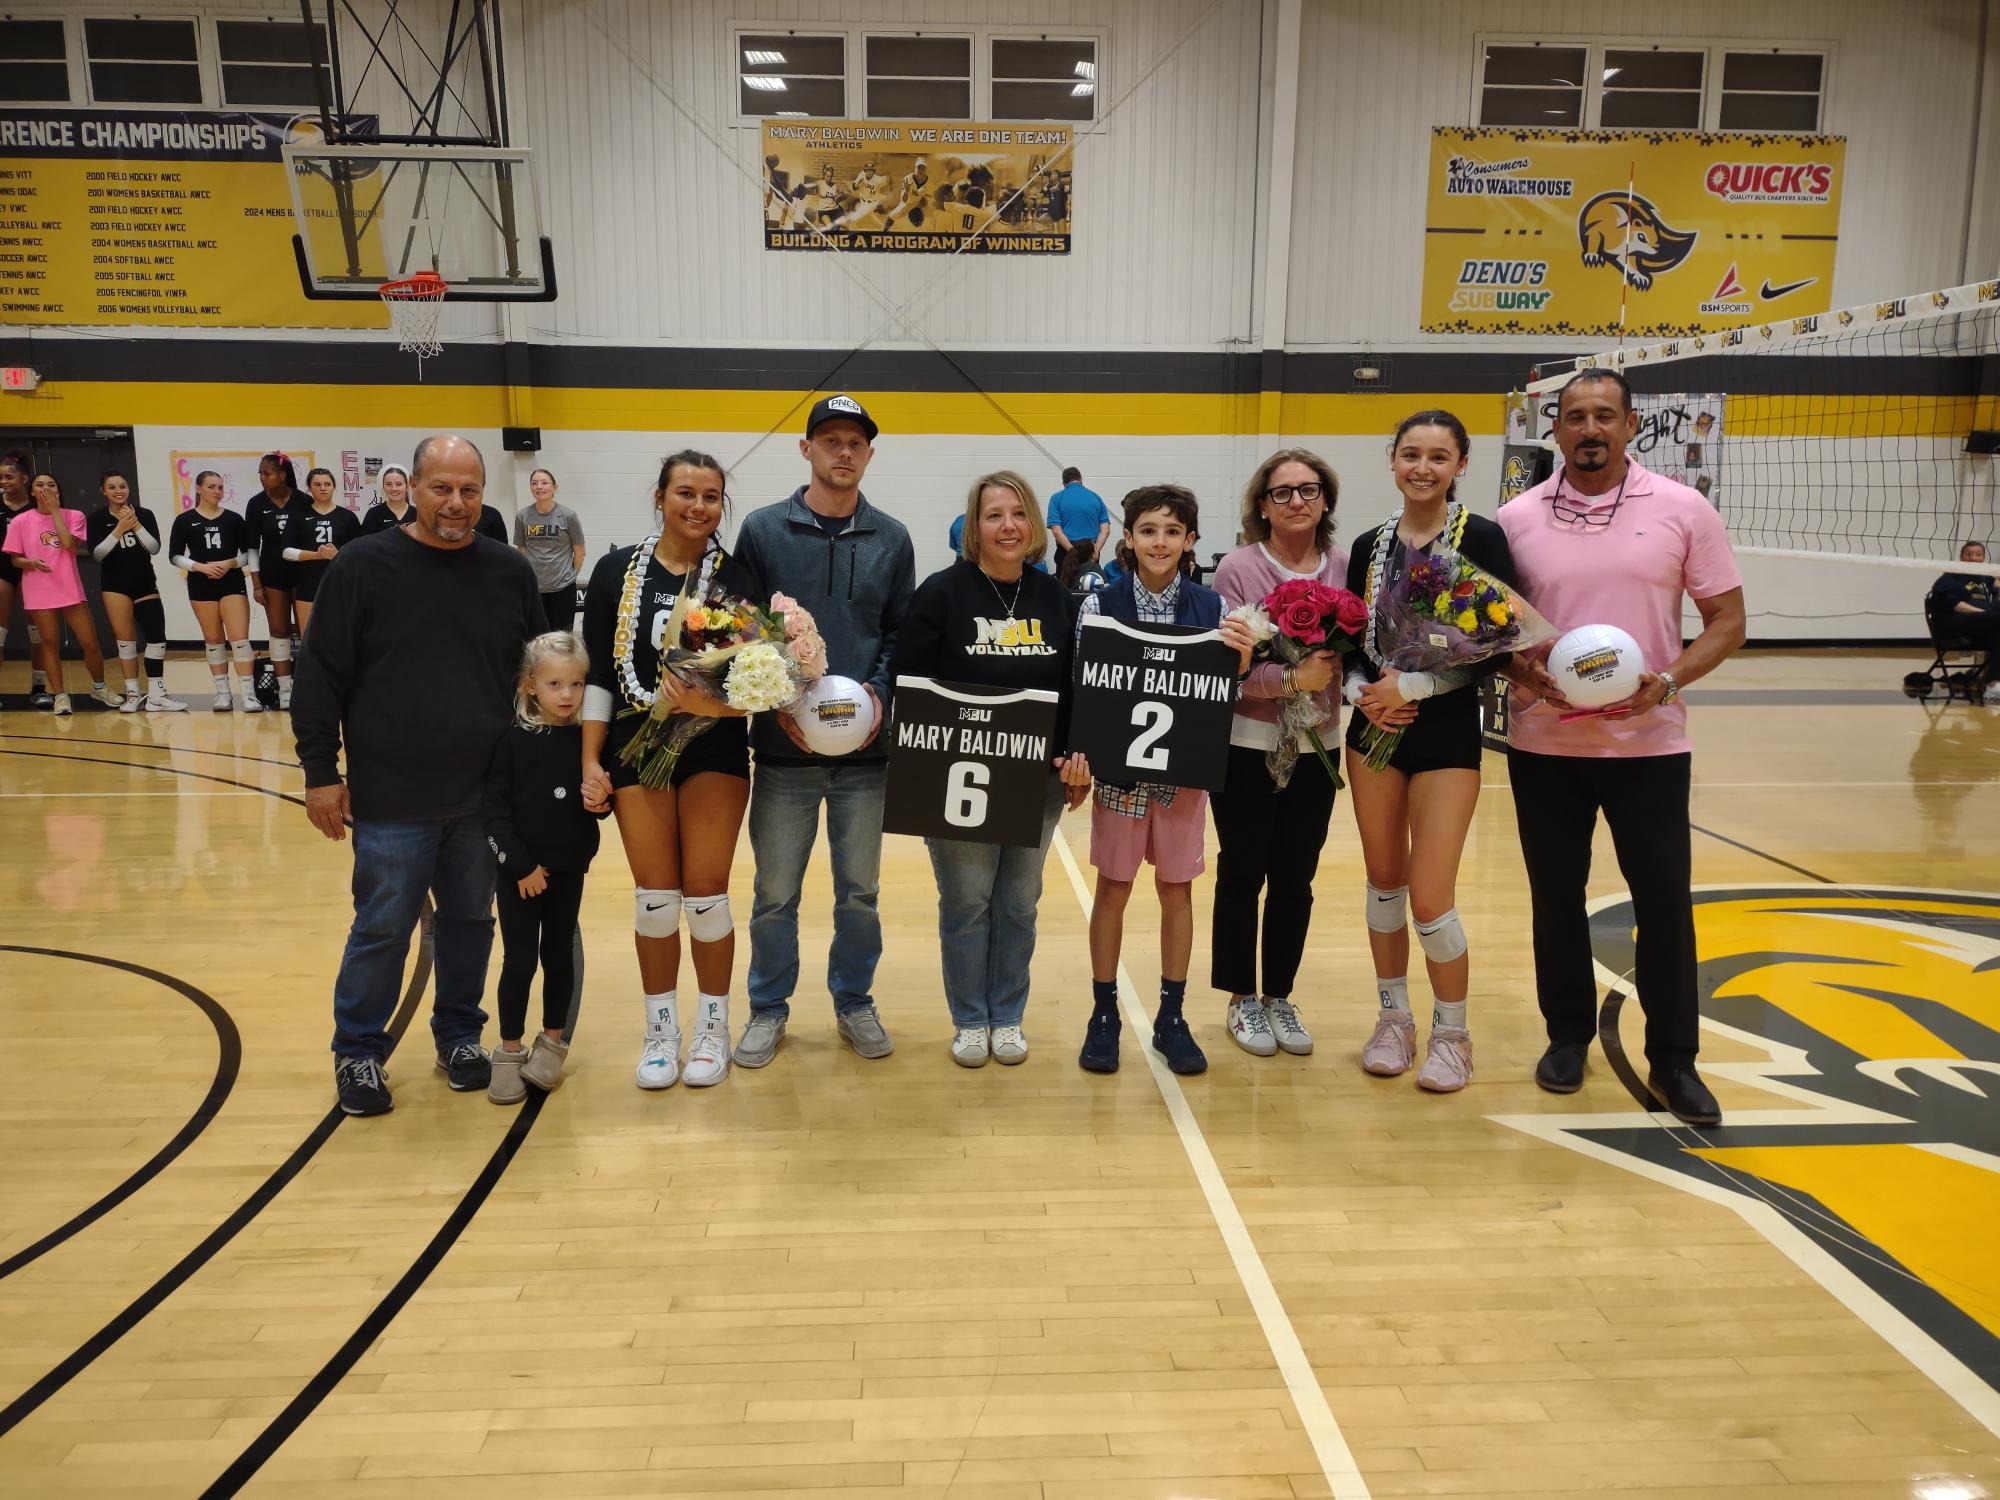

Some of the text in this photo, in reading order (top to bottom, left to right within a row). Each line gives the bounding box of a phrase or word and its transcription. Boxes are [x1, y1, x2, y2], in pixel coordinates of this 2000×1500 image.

[81, 121, 266, 150] CHAMPIONSHIPS
[768, 126, 899, 140] MARY BALDWIN
[909, 128, 1067, 145] WE ARE ONE TEAM!
[805, 141, 863, 149] ATHLETICS
[1463, 158, 1529, 177] Consumers
[86, 172, 181, 182] 2000 FIELD HOCKEY AWCC
[1706, 163, 1831, 197] QUICK'S
[88, 189, 211, 199] 2001 WOMENS BASKETBALL AWCC
[1448, 178, 1572, 196] AUTO WAREHOUSE
[89, 205, 182, 216] 2001 FIELD HOCKEY AWCC
[244, 208, 264, 217] 2024
[266, 208, 285, 218] MENS
[42, 221, 62, 230] AWCC
[90, 222, 187, 232] 2003 FIELD HOCKEY AWCC
[22, 238, 43, 246] AWCC
[92, 238, 218, 249] 2004 WOMENS BASKETBALL AWCC
[771, 234, 1065, 251] BUILDING A PROGRAM OF WINNERS
[27, 255, 48, 263] AWCC
[93, 255, 175, 265] 2004 SOFTBALL AWCC
[26, 271, 46, 280] AWCC
[95, 272, 176, 281] 2005 SOFTBALL AWCC
[1460, 261, 1546, 284] DENO'S
[18, 287, 40, 296] AWCC
[96, 288, 115, 297] 2006
[1453, 290, 1551, 310] SUBWAY
[2, 303, 64, 313] SWIMMING AWCC
[98, 304, 222, 315] 2006 WOMENS VOLLEYBALL AWCC
[1701, 304, 1750, 313] BSN SPORTS
[1876, 299, 1906, 321] MBU
[1792, 315, 1818, 335] MBU
[1720, 330, 1743, 348] MBU
[1628, 404, 1692, 453] ight
[120, 531, 137, 549] 16
[204, 532, 221, 549] 14
[315, 526, 332, 542] 21
[653, 592, 678, 606] MB
[973, 616, 1045, 647] MBU
[965, 644, 1057, 656] VOLLEYBALL
[1142, 646, 1176, 662] MBU
[1082, 661, 1230, 702] MARY BALDWIN
[958, 707, 993, 722] MBU
[898, 722, 1046, 761] MARY BALDWIN
[1125, 701, 1174, 771] 2
[944, 761, 990, 828] 6
